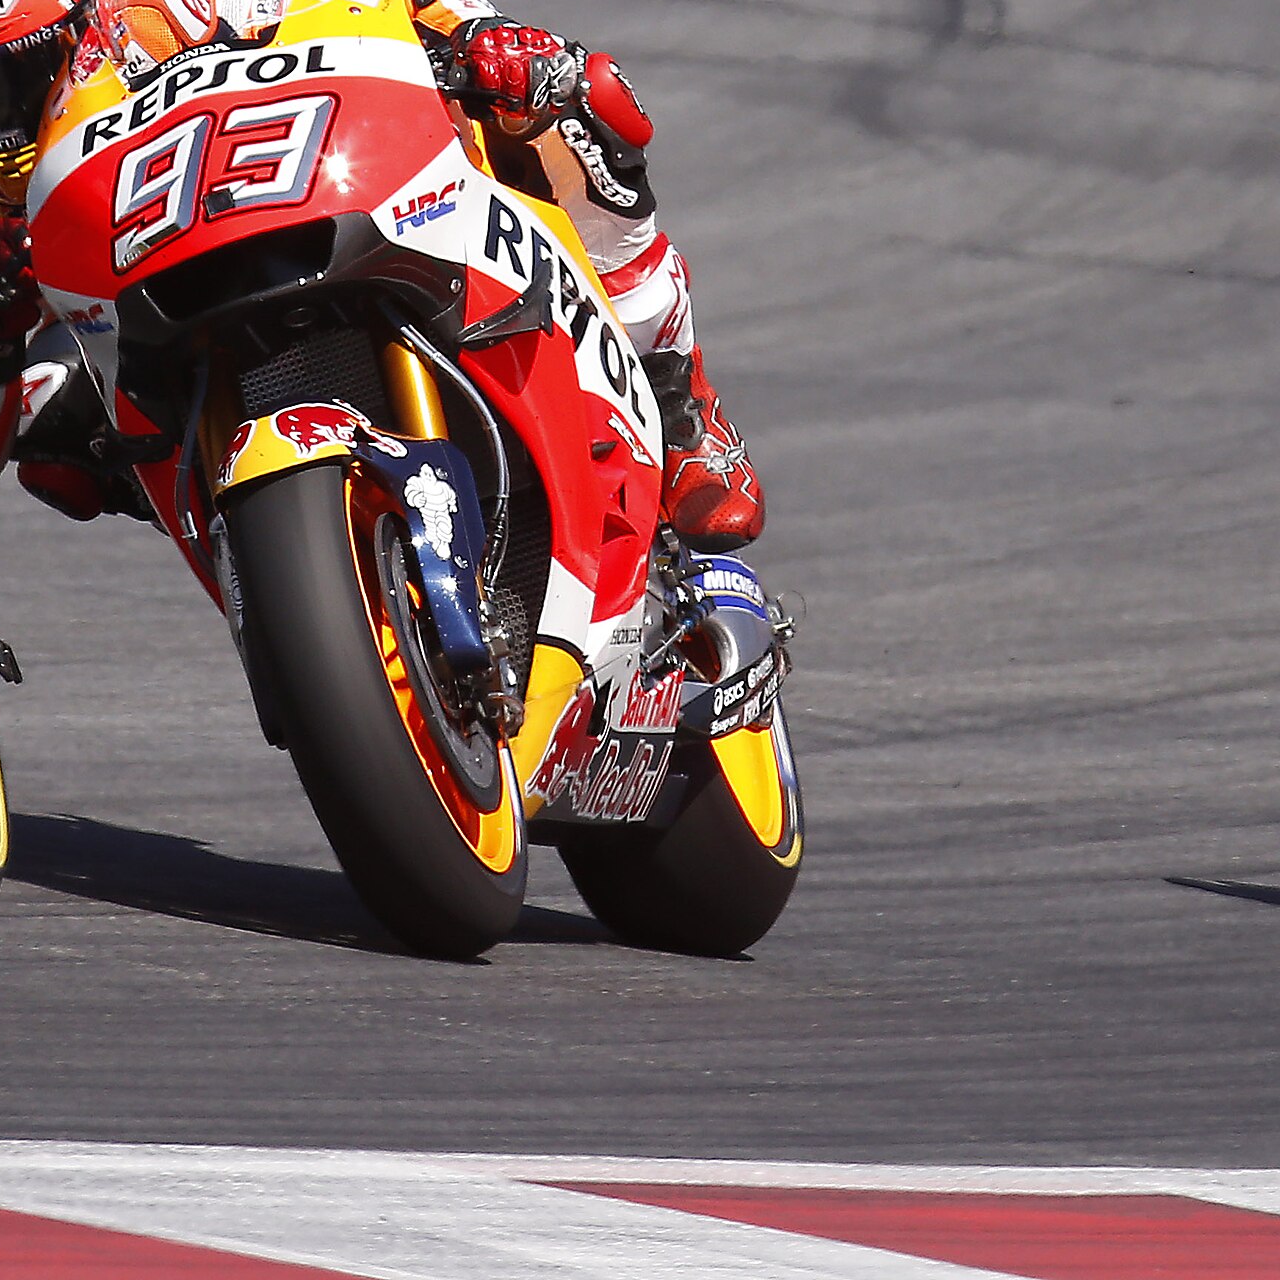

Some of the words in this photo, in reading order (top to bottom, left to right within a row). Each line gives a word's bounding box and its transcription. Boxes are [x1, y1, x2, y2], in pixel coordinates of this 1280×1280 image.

[6, 23, 62, 53] WINGS
[159, 43, 231, 73] HONDA
[81, 46, 335, 157] REPSOL
[113, 94, 337, 270] 93
[392, 181, 457, 236] HRC
[703, 570, 764, 604] MICHEL
